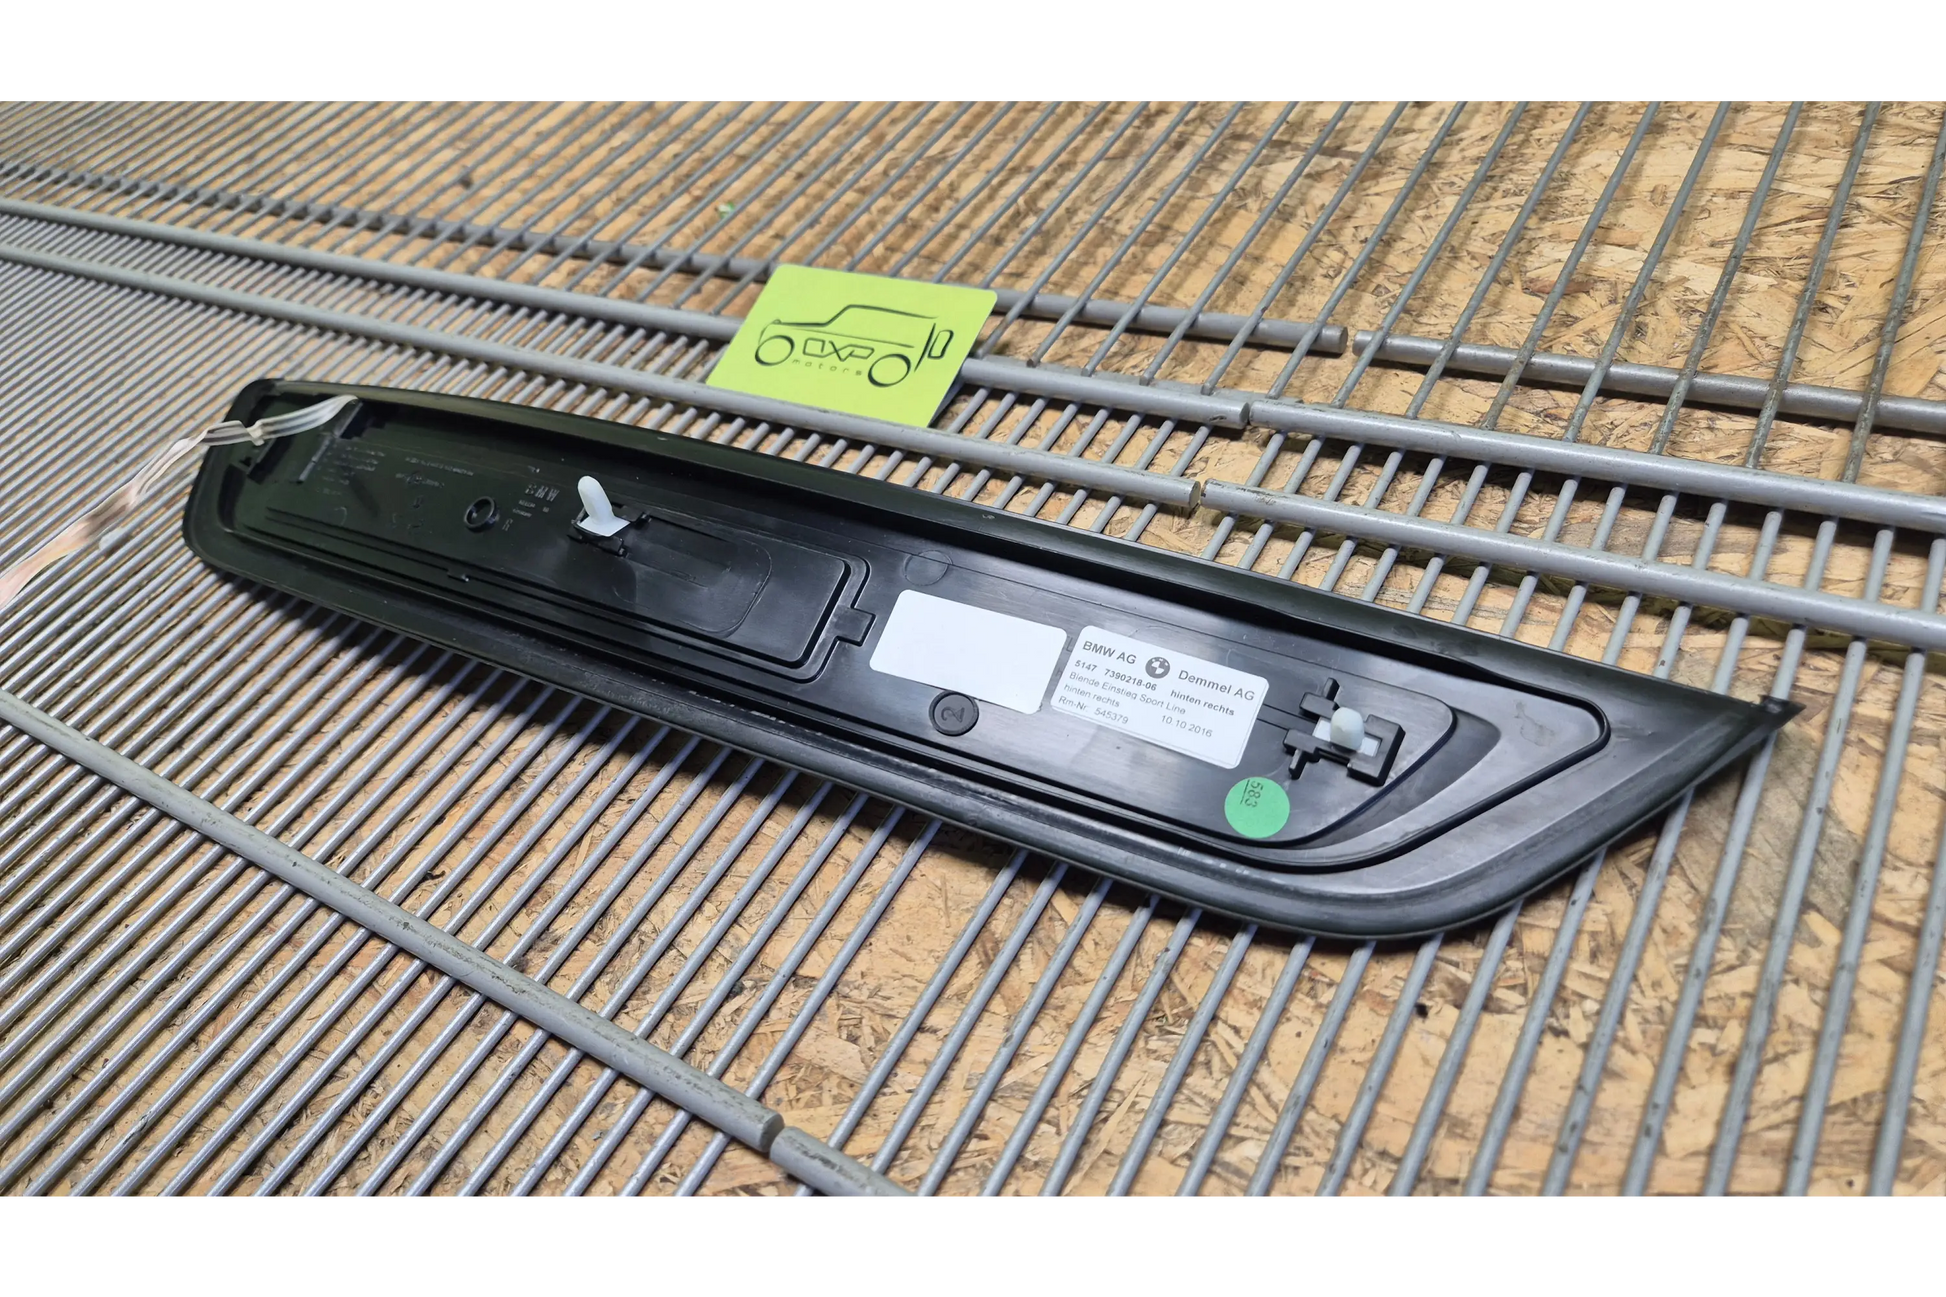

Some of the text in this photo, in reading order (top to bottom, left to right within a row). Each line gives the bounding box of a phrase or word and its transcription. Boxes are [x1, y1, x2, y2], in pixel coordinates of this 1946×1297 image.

[792, 358, 863, 376] motors
[1082, 640, 1116, 658] BMW
[1116, 651, 1137, 665] AG
[1063, 683, 1120, 708] hinten rechts
[1069, 671, 1100, 687] Blende
[1101, 681, 1137, 700] Einstieg
[1139, 693, 1164, 709] Sport
[1165, 701, 1186, 715] Line
[1074, 659, 1097, 672] 5147
[1104, 668, 1157, 691] 7390218-06
[1170, 689, 1202, 705] hinten
[1203, 698, 1235, 716] rechts
[1178, 669, 1255, 701] Demmel AG
[1093, 707, 1129, 725] 545379
